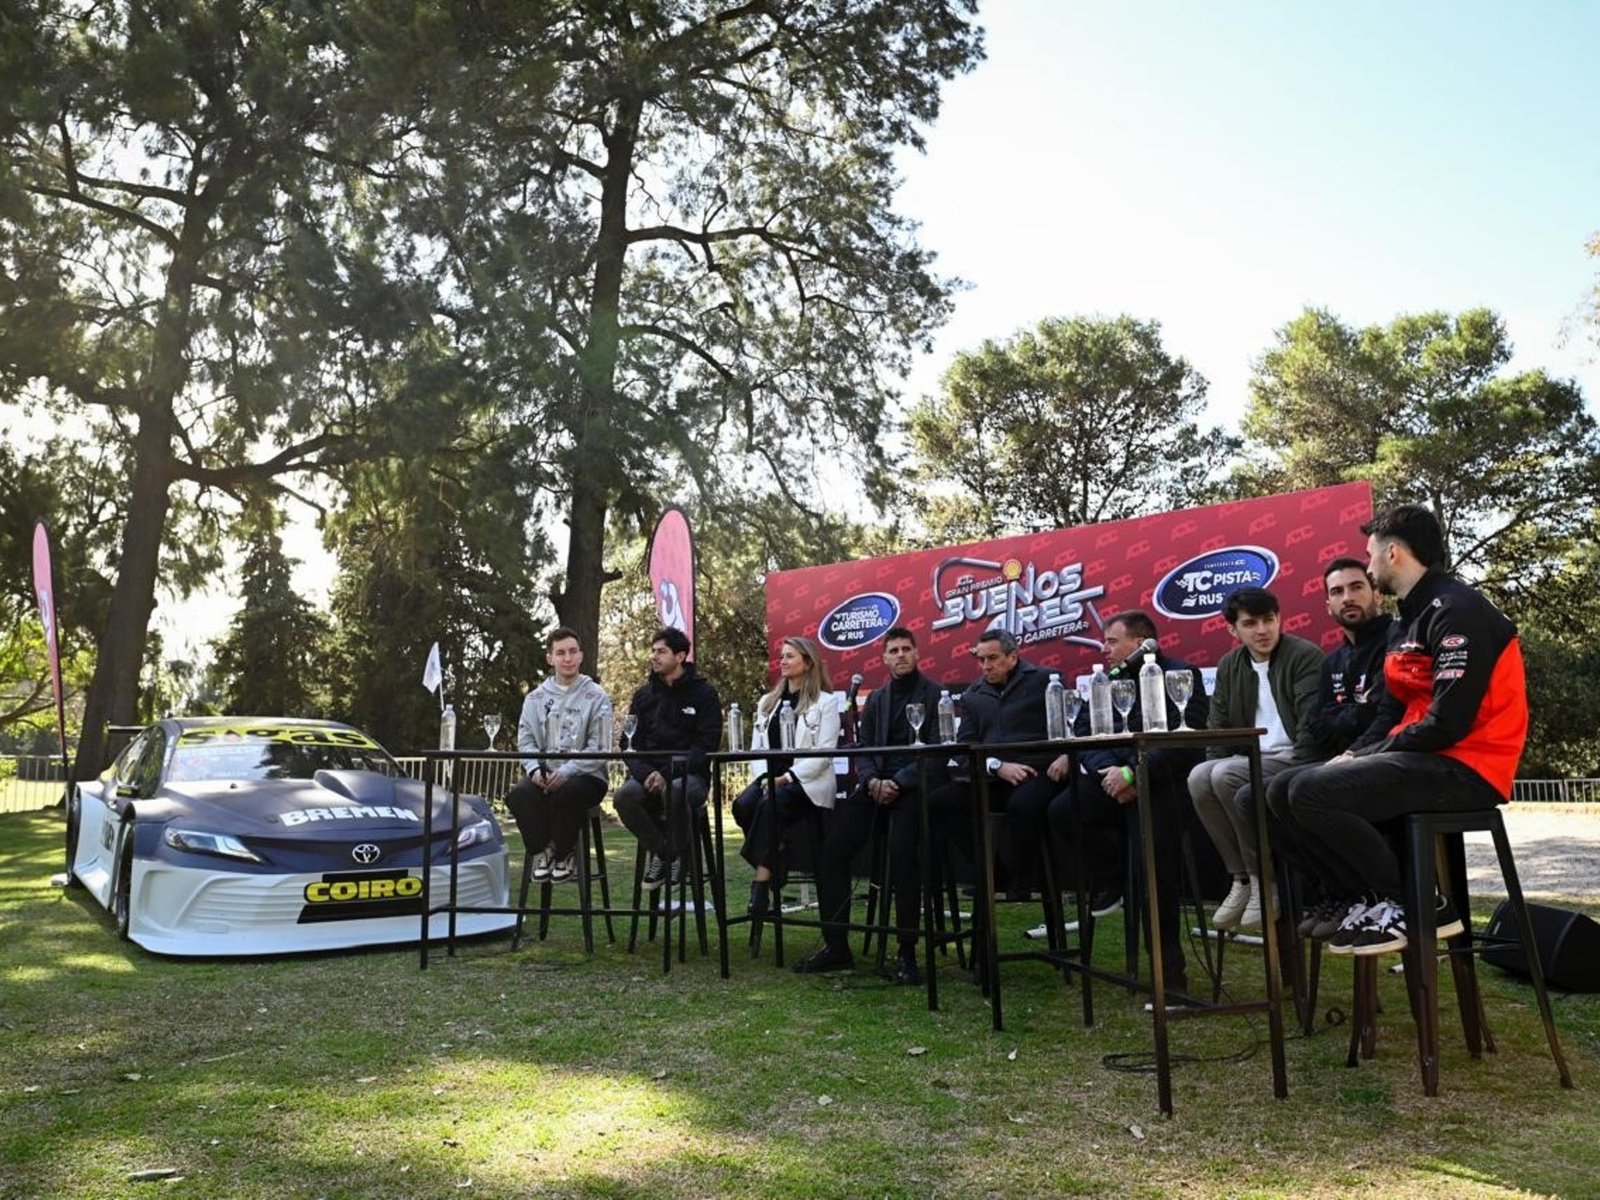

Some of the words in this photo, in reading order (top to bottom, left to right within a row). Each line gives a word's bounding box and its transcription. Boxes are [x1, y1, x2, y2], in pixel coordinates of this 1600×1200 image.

[1182, 570, 1213, 592] TC
[1213, 570, 1252, 586] PISTA
[932, 561, 1082, 629] BUENOS
[1198, 593, 1224, 606] RUS
[831, 617, 883, 632] CARRETERA
[840, 609, 880, 621] TURISMO
[847, 631, 865, 640] RUS
[1024, 620, 1082, 642] CARRETERA
[279, 806, 419, 827] BREMEN
[306, 878, 422, 902] COIRO
